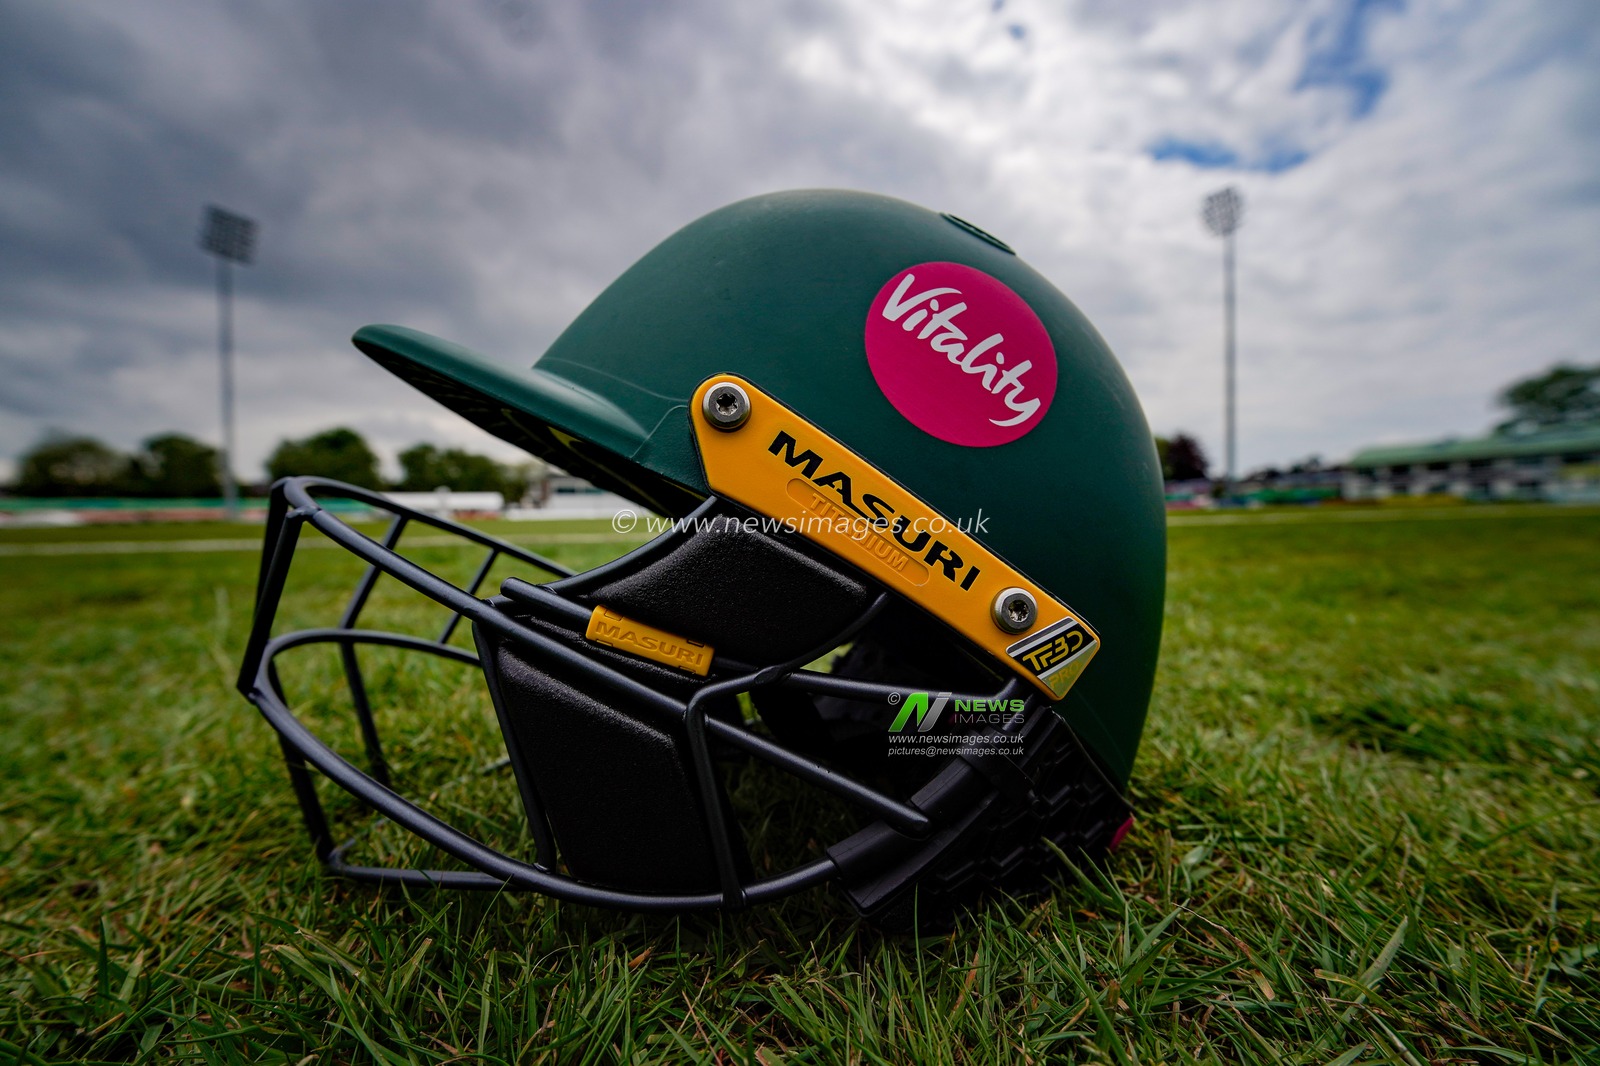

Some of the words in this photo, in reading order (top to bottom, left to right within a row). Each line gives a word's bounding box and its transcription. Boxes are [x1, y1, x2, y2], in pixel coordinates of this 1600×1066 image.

[882, 273, 1041, 426] Vitality
[768, 430, 980, 591] MASURI
[595, 621, 703, 665] MASURI
